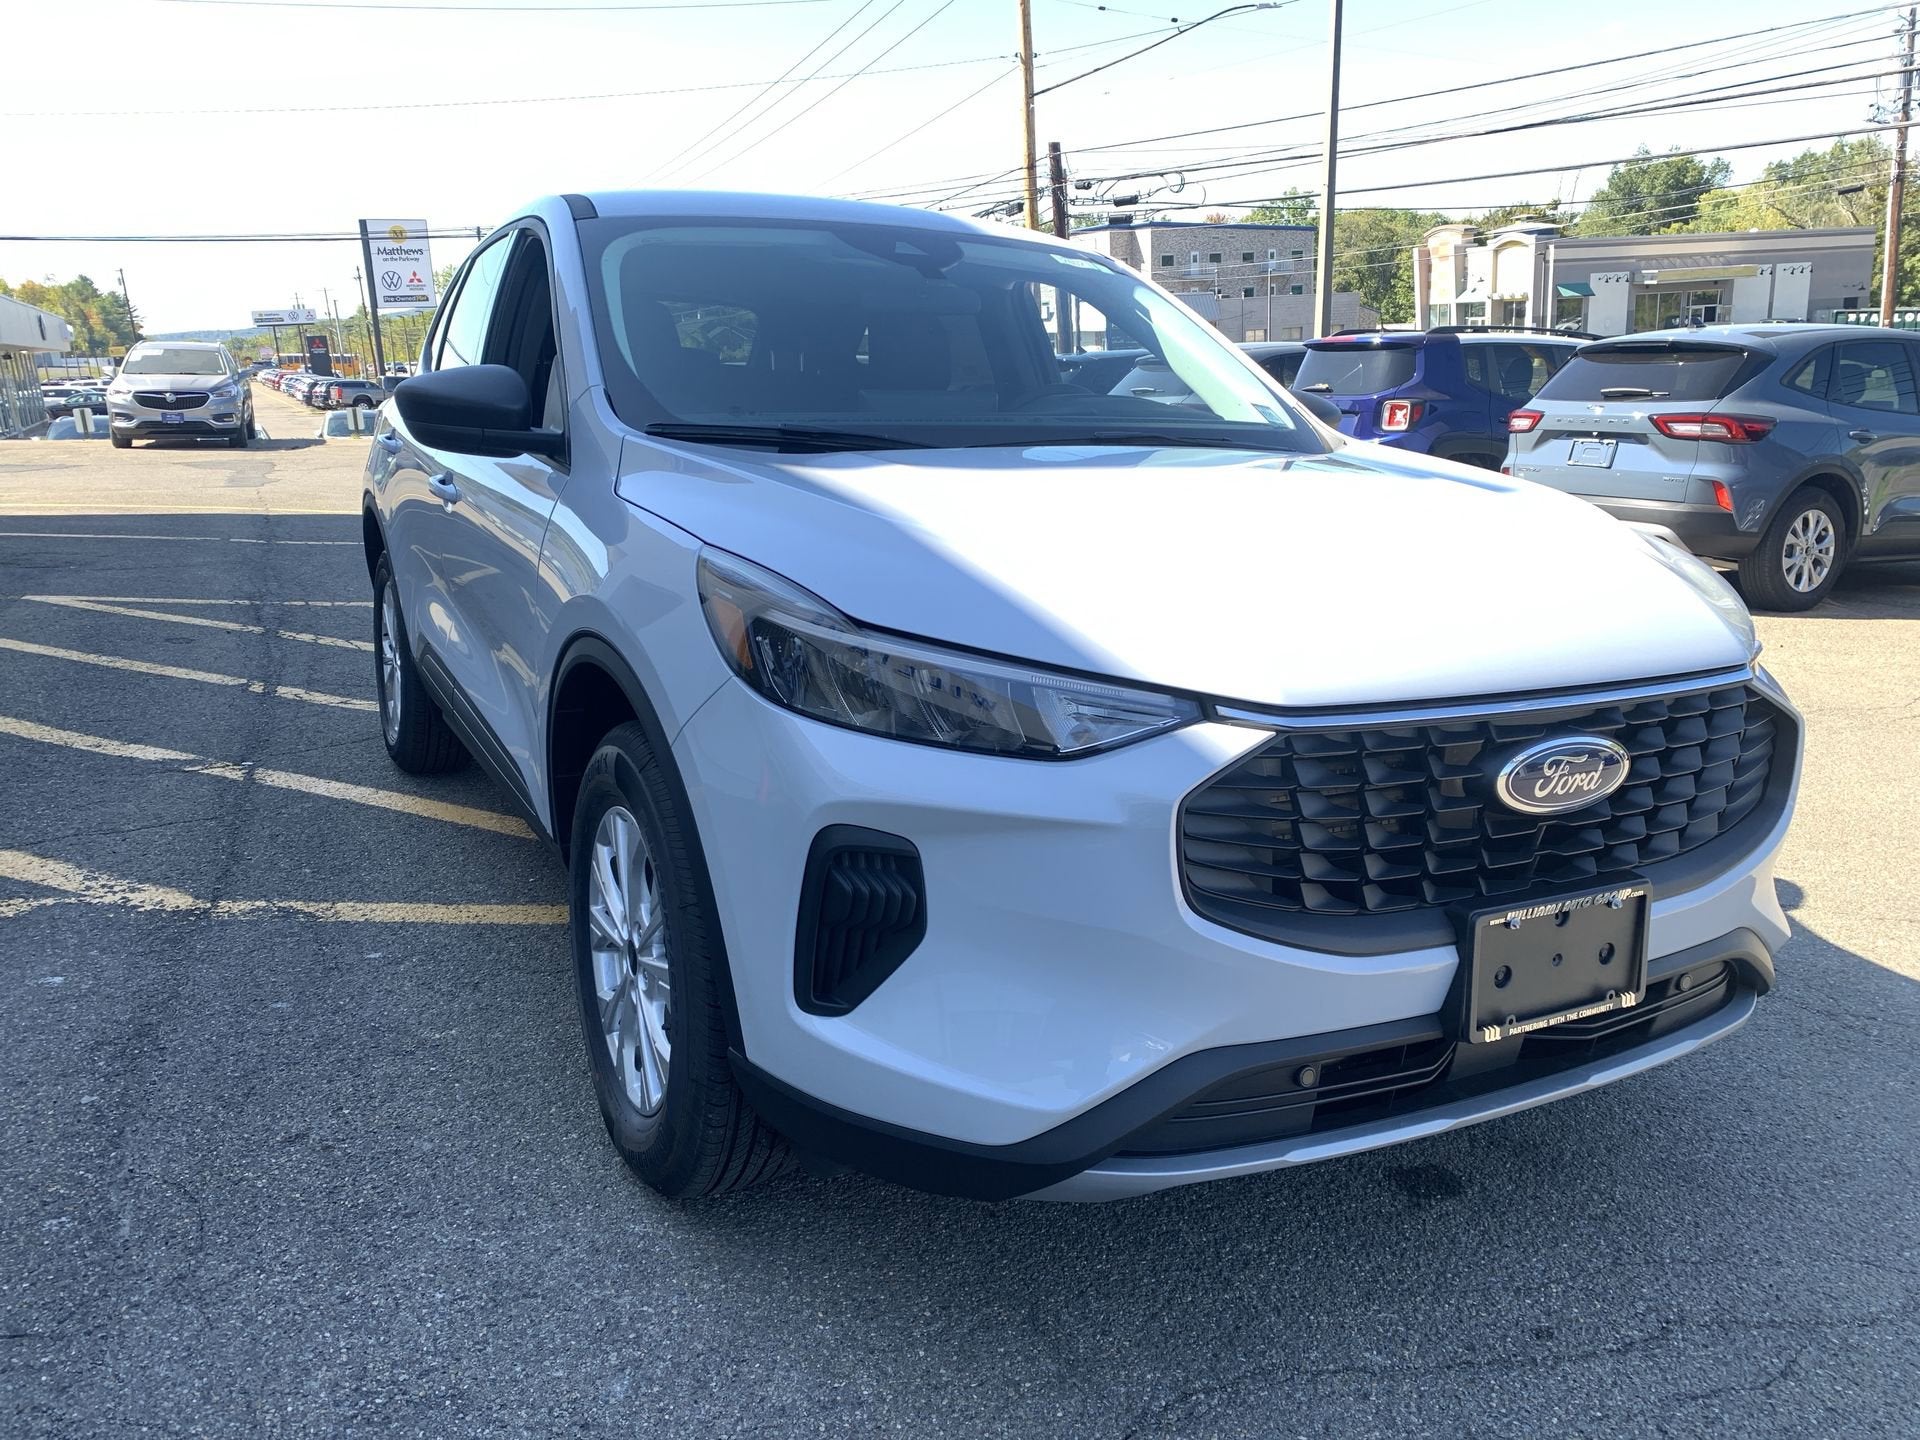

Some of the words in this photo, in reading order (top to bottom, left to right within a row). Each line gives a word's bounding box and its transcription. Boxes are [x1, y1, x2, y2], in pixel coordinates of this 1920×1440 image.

[377, 245, 424, 256] Matthews
[1534, 754, 1604, 798] Ford
[1562, 895, 1593, 912] AUTO
[1508, 1018, 1548, 1036] PARTNERING
[1549, 1014, 1565, 1026] WITH
[1566, 1010, 1578, 1021] THE
[1578, 1002, 1614, 1019] COMMUNITY
